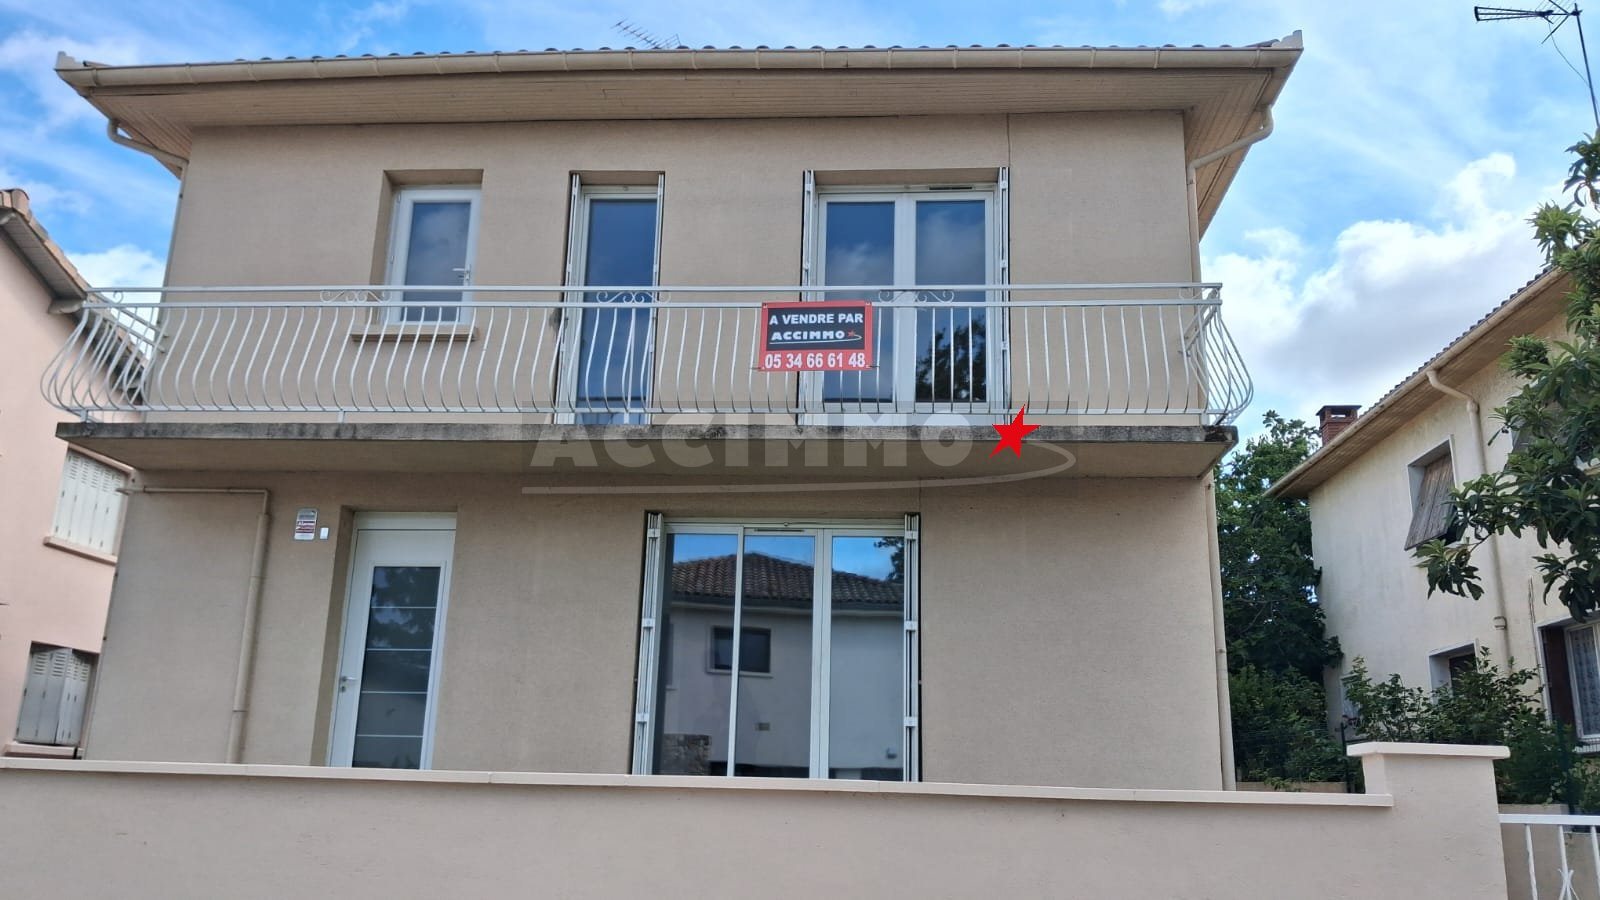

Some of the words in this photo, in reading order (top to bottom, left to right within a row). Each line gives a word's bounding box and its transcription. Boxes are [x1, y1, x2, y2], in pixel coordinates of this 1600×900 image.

[769, 315, 778, 325] A
[782, 313, 834, 325] VENDRE
[838, 313, 863, 324] PAR
[771, 331, 845, 340] ACCIMMO
[765, 353, 781, 368] 05
[786, 353, 802, 368] 34
[807, 352, 823, 368] 66
[828, 352, 842, 367] 61
[848, 352, 865, 367] 48
